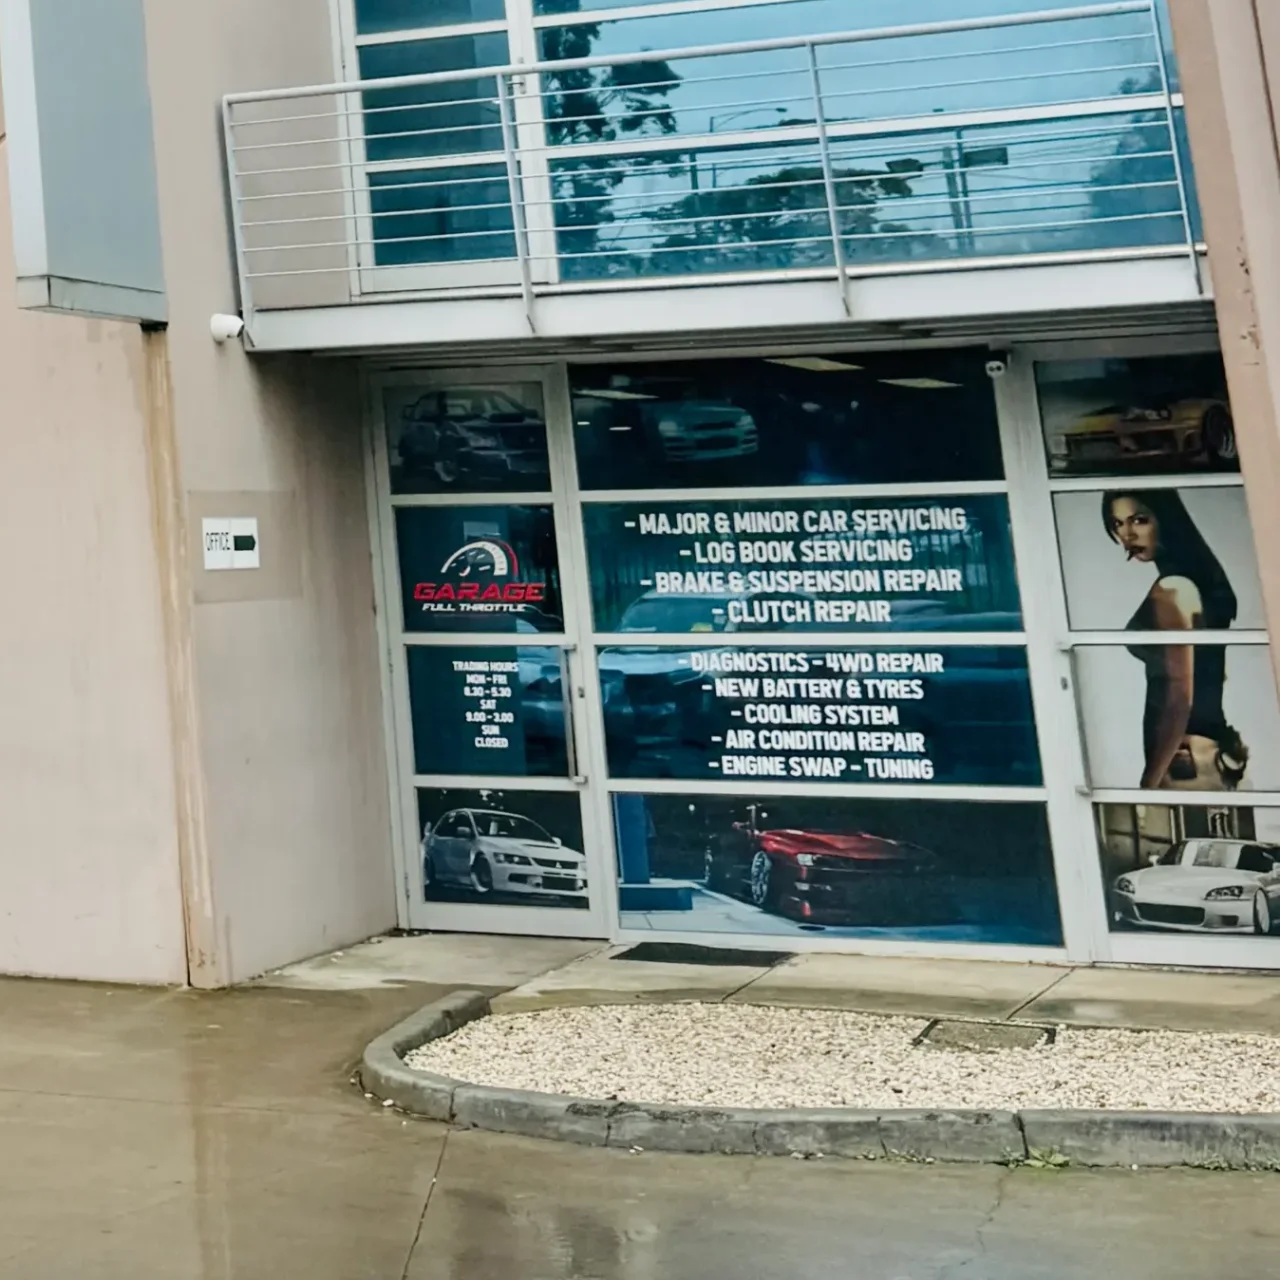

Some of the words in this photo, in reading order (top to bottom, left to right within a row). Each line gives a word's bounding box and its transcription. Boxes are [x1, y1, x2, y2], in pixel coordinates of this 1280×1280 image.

[639, 512, 711, 535] MAJOR
[713, 512, 731, 534] &
[733, 511, 800, 533] MINOR
[803, 509, 848, 533] CAR
[851, 507, 967, 532] SERVICING
[694, 541, 736, 564] LOG
[738, 541, 797, 563] BOOK
[799, 539, 913, 563] SERVICING
[413, 582, 546, 601] GARAGE
[655, 571, 725, 593] BRAKE
[727, 571, 745, 593] &
[747, 570, 881, 593] SUSPENSION
[883, 569, 963, 592] REPAIR
[422, 603, 456, 612] FULL
[459, 603, 527, 612] THROTTLE
[727, 600, 811, 623] CLUTCH
[813, 600, 892, 622] REPAIR
[490, 661, 519, 672] HOURS
[691, 652, 809, 672] DIAGNOSTICS
[825, 652, 874, 673] 4WD
[876, 652, 945, 673] REPAIR
[715, 678, 759, 698] NEW
[762, 678, 843, 699] BATTERY
[846, 679, 862, 699] &
[863, 679, 924, 700] TYRES
[480, 699, 497, 710] SAT
[744, 703, 822, 724] COOLING
[824, 704, 900, 726] SYSTEM
[474, 737, 509, 748] CLOSED
[725, 729, 756, 749] AIR
[758, 730, 856, 751] CONDITION
[857, 731, 926, 752] REPAIR
[721, 755, 787, 776] ENGINE
[788, 756, 847, 777] SWAP
[864, 757, 934, 780] TUNING
